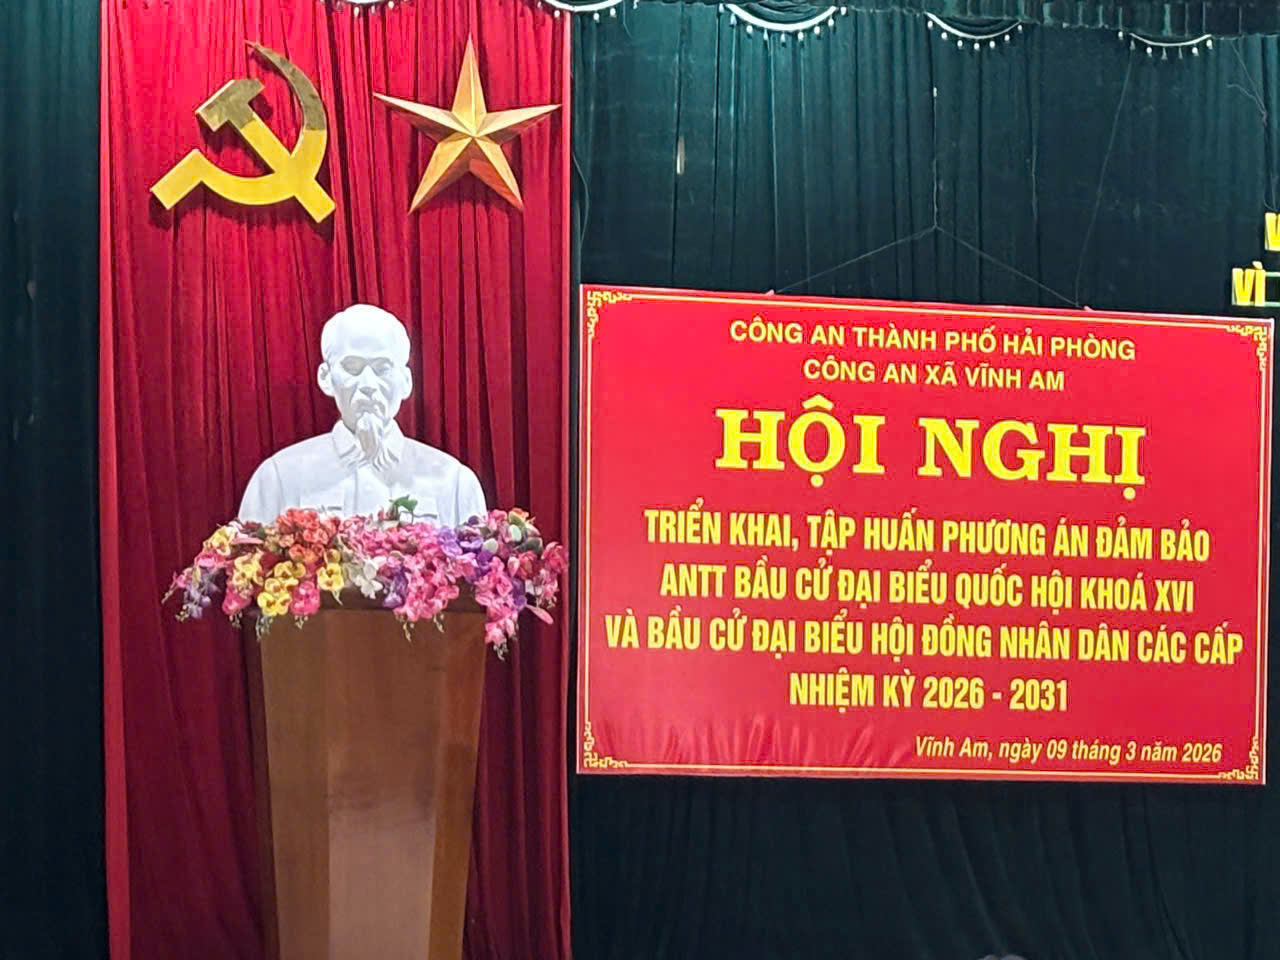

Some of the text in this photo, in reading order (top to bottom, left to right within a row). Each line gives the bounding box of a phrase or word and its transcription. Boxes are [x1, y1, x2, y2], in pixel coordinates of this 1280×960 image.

[1232, 262, 1265, 307] VÌ
[729, 315, 1136, 361] CÔNG AN THÀNH PHỐ HẢI PHÒNG
[803, 354, 1065, 392] CÔNG AN XÃ VĨNH AM
[714, 393, 1147, 501] HỘI NGHỊ
[643, 497, 1210, 563] TRIỂN KHAI, TẬP HUẤN PHƯƠNG ÁN ĐẢM BẢO
[659, 554, 1195, 616] ANTT BẦU CỬ ĐẠI BIỂU QUỐC HỘI KHOÁ XVI
[604, 604, 1244, 665] VÀ BẦU CỬ ĐẠI BIỂU HỘI ĐỒNG NHÂN DÂN CÁC CẤP
[789, 666, 1068, 714] NHIỆM KỲ 2026 - 2031
[915, 735, 1223, 766] Vĩnh Am, ngày 09 tháng 3 năm 2026
